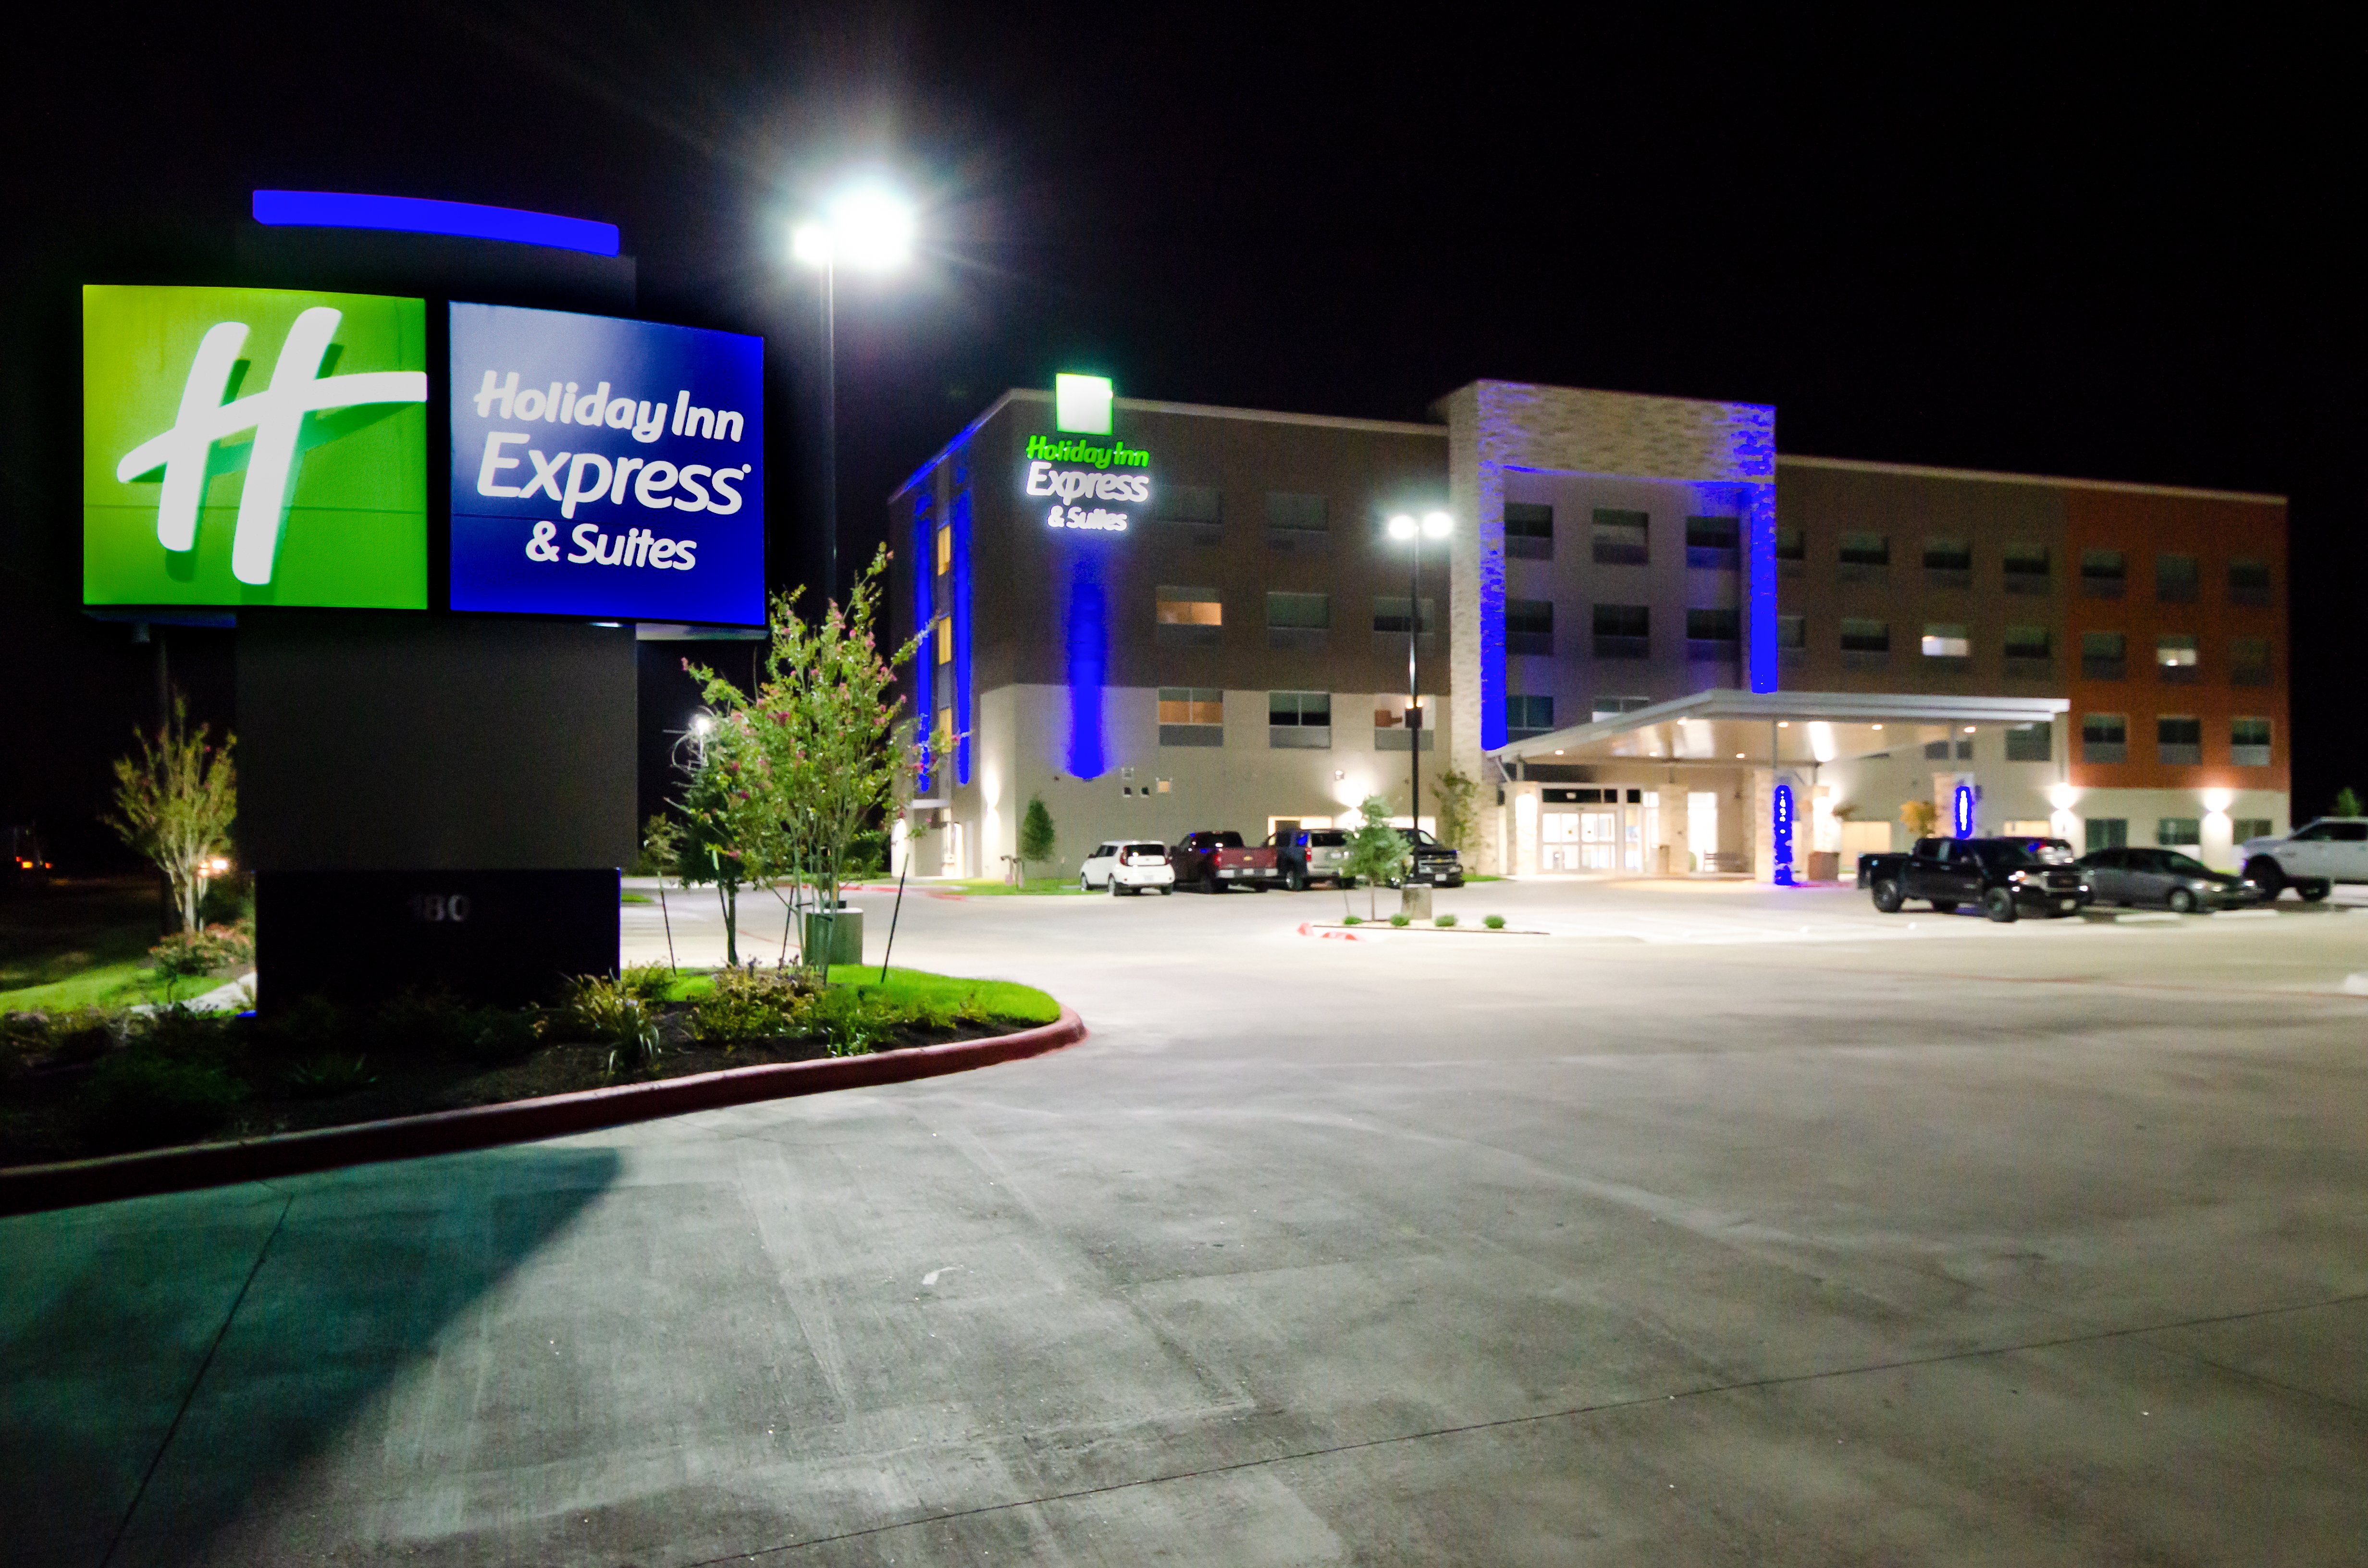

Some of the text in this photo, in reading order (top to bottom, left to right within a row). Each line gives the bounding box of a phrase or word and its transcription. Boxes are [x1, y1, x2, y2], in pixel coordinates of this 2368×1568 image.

[473, 370, 744, 443] Holiday Inn
[116, 306, 428, 586] H
[1026, 435, 1150, 469] Holiday Inn
[476, 431, 752, 519] Express
[1026, 462, 1149, 505] Express
[1048, 505, 1126, 531] & Suites
[526, 521, 697, 570] & Suites
